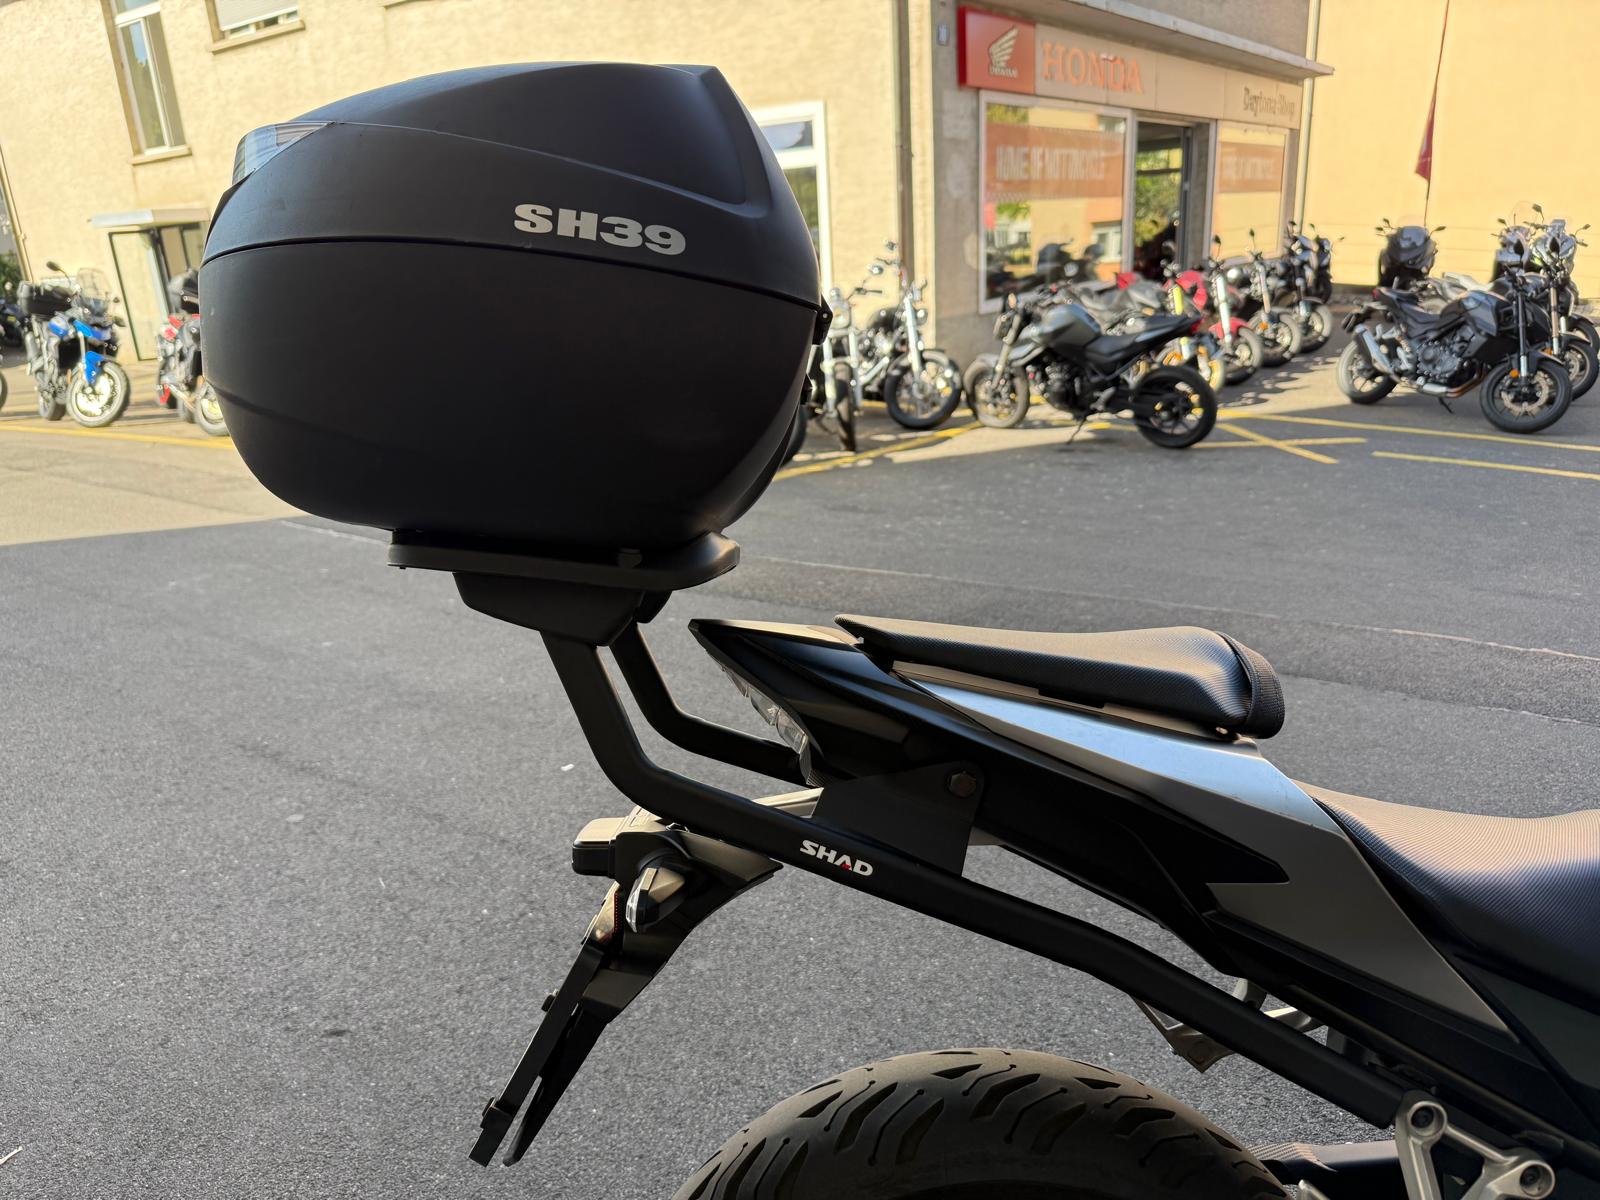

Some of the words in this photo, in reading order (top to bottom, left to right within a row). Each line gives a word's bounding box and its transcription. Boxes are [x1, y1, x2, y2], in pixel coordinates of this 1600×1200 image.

[1041, 42, 1145, 95] HONDA
[513, 203, 687, 256] SH39
[799, 839, 874, 877] SHAD
